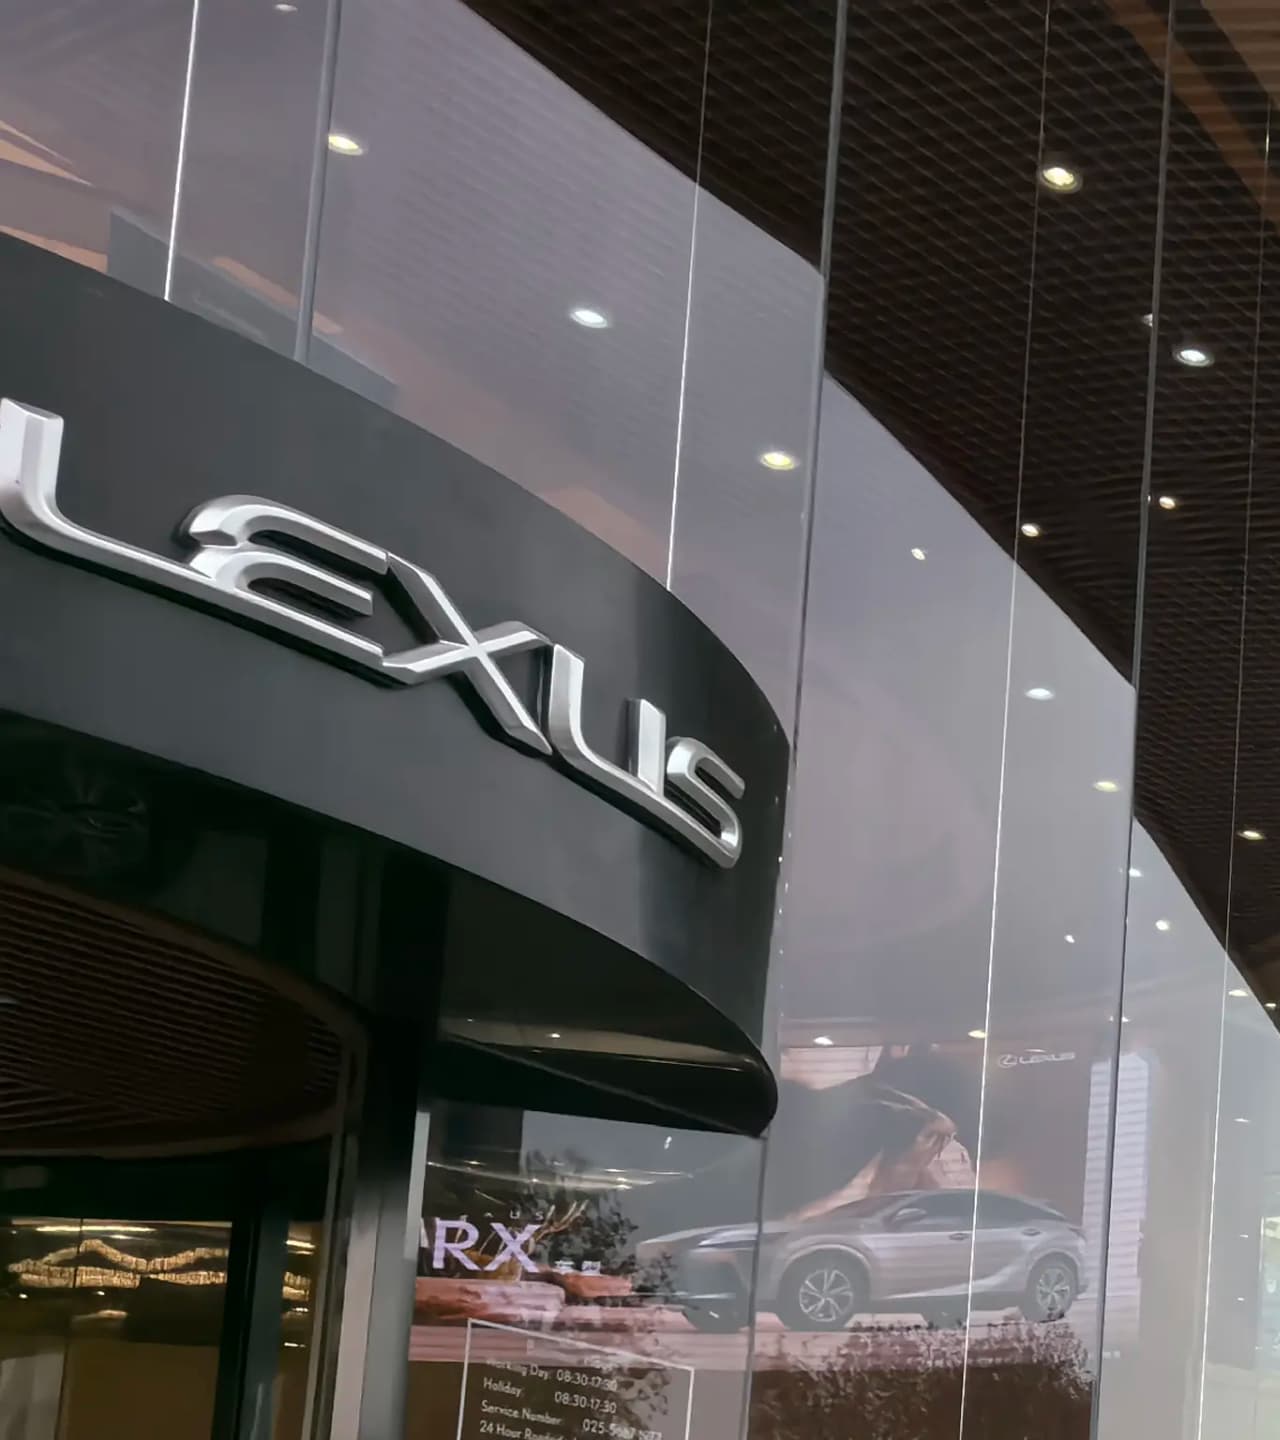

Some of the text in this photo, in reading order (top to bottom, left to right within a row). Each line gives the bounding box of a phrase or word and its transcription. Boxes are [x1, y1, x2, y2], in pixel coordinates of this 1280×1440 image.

[0, 398, 746, 870] LEXUS
[432, 1217, 542, 1273] RX
[481, 1400, 520, 1418] Service
[479, 1420, 494, 1434] 24
[496, 1423, 522, 1438] Hour
